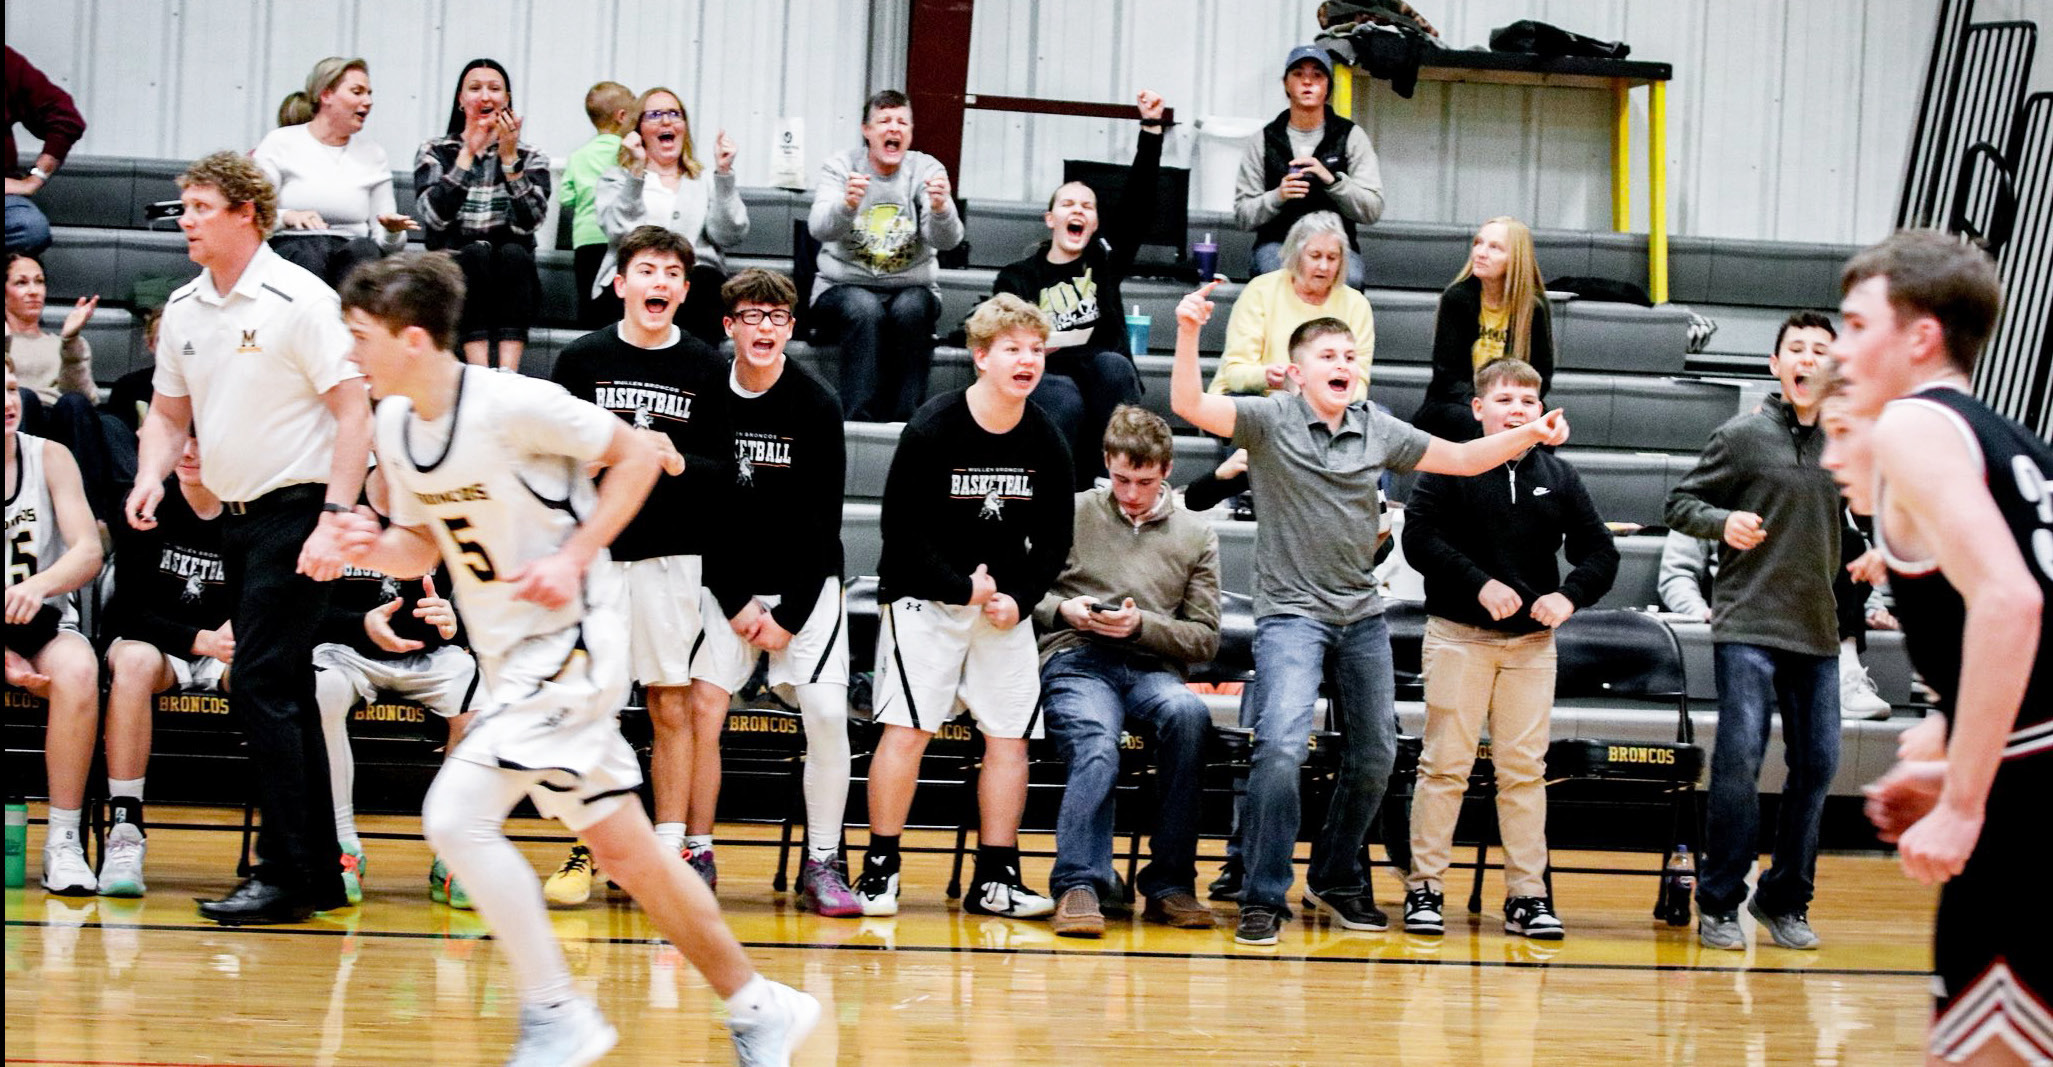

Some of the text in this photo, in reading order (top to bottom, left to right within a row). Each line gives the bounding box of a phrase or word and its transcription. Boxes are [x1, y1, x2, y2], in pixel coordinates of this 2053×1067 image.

[595, 387, 692, 419] BASKETBALL
[441, 517, 497, 582] 5
[159, 696, 230, 714] BRONCOS
[355, 704, 425, 722] BRONCOS
[729, 715, 798, 733] BRONCOS
[1608, 746, 1675, 764] BRONCOS
